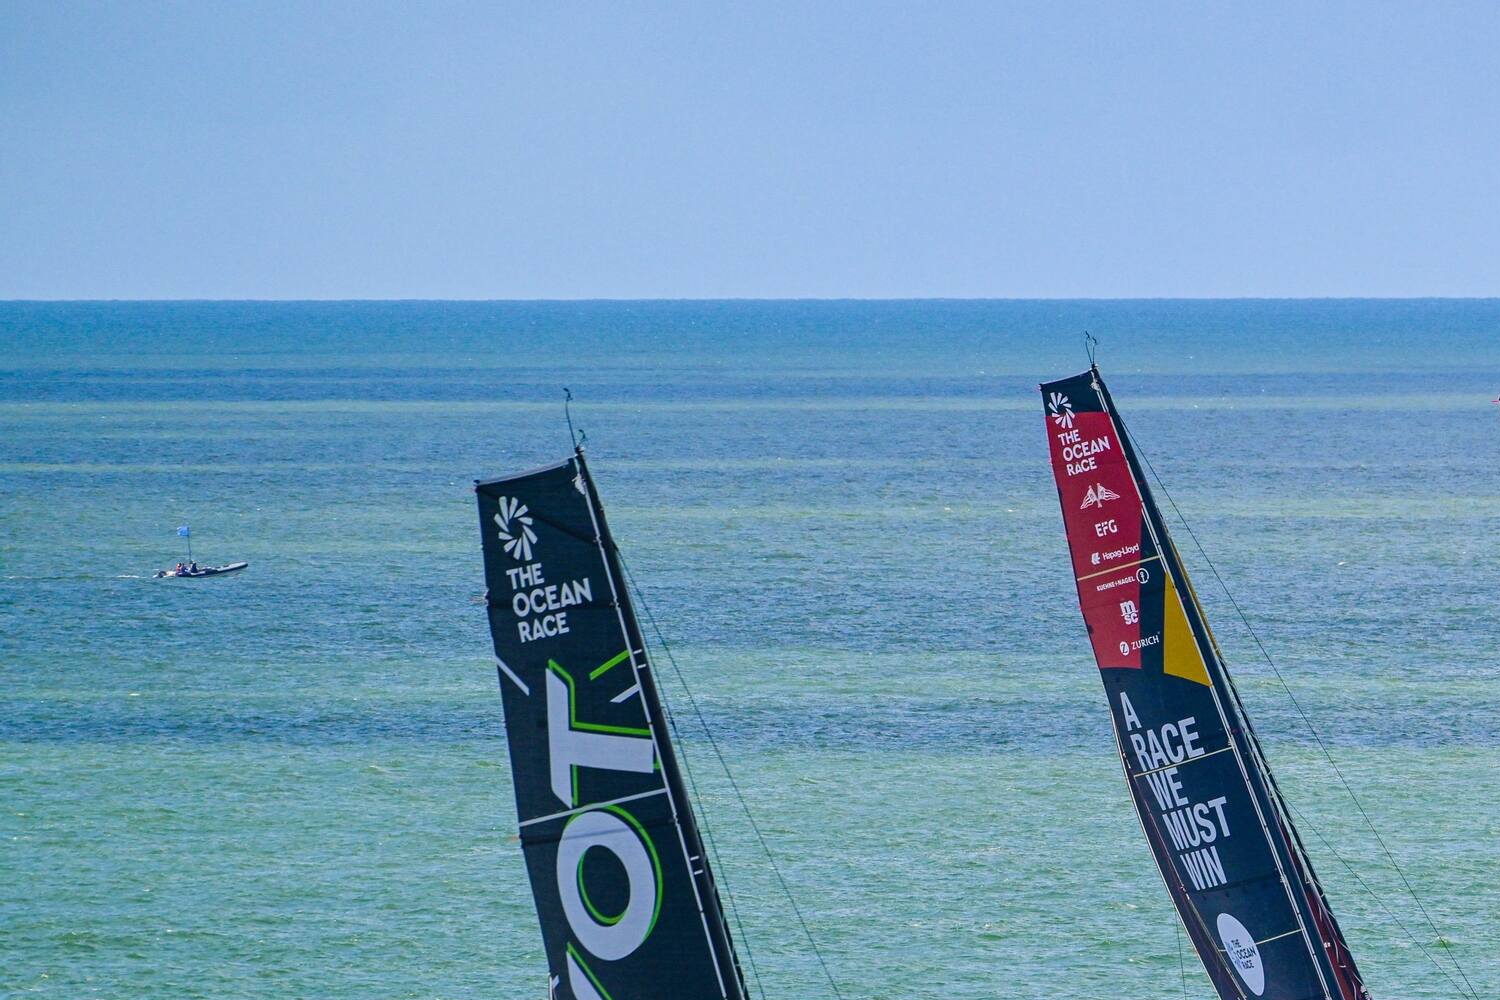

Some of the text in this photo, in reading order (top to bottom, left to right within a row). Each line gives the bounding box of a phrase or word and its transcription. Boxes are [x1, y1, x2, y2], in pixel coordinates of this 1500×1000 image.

[1058, 429, 1081, 446] THE
[1062, 436, 1111, 462] OCEAN
[1066, 457, 1097, 477] RACE
[1095, 519, 1118, 537] EFG
[1102, 543, 1140, 561] Hapag-Lloyd
[506, 562, 545, 591] THE
[512, 577, 592, 617] OCEAN
[517, 612, 570, 643] RACE
[1131, 634, 1160, 650] ZURICH
[1120, 691, 1142, 731] A
[1130, 716, 1205, 772] RACE
[1146, 767, 1189, 811] WE
[1162, 796, 1232, 851] MUST
[1180, 845, 1228, 891] WIN
